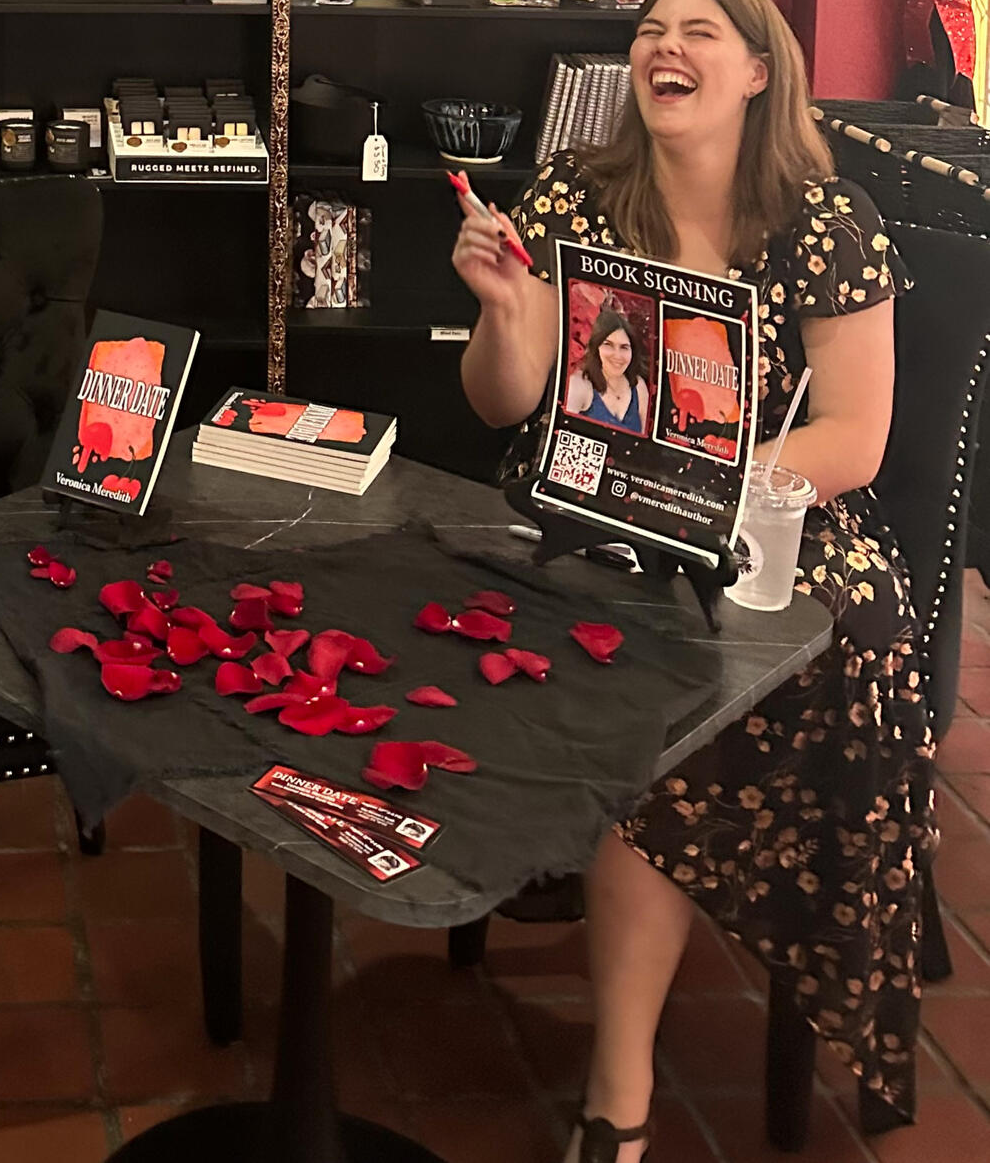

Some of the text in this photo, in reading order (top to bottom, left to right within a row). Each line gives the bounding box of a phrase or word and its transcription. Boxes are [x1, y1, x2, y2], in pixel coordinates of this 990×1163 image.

[580, 255, 735, 308] BOOK SIGNING
[665, 348, 740, 392] DINNER DATE
[77, 368, 134, 411] DINNER
[130, 381, 170, 421] DATE
[665, 428, 729, 454] Veronica Meredith
[56, 472, 131, 504] Veronica Meredith
[607, 467, 725, 511] www. veronicameredith.com
[630, 491, 713, 526] @vmeredithauthor
[272, 771, 322, 792] DINNER
[322, 788, 359, 805] DATE
